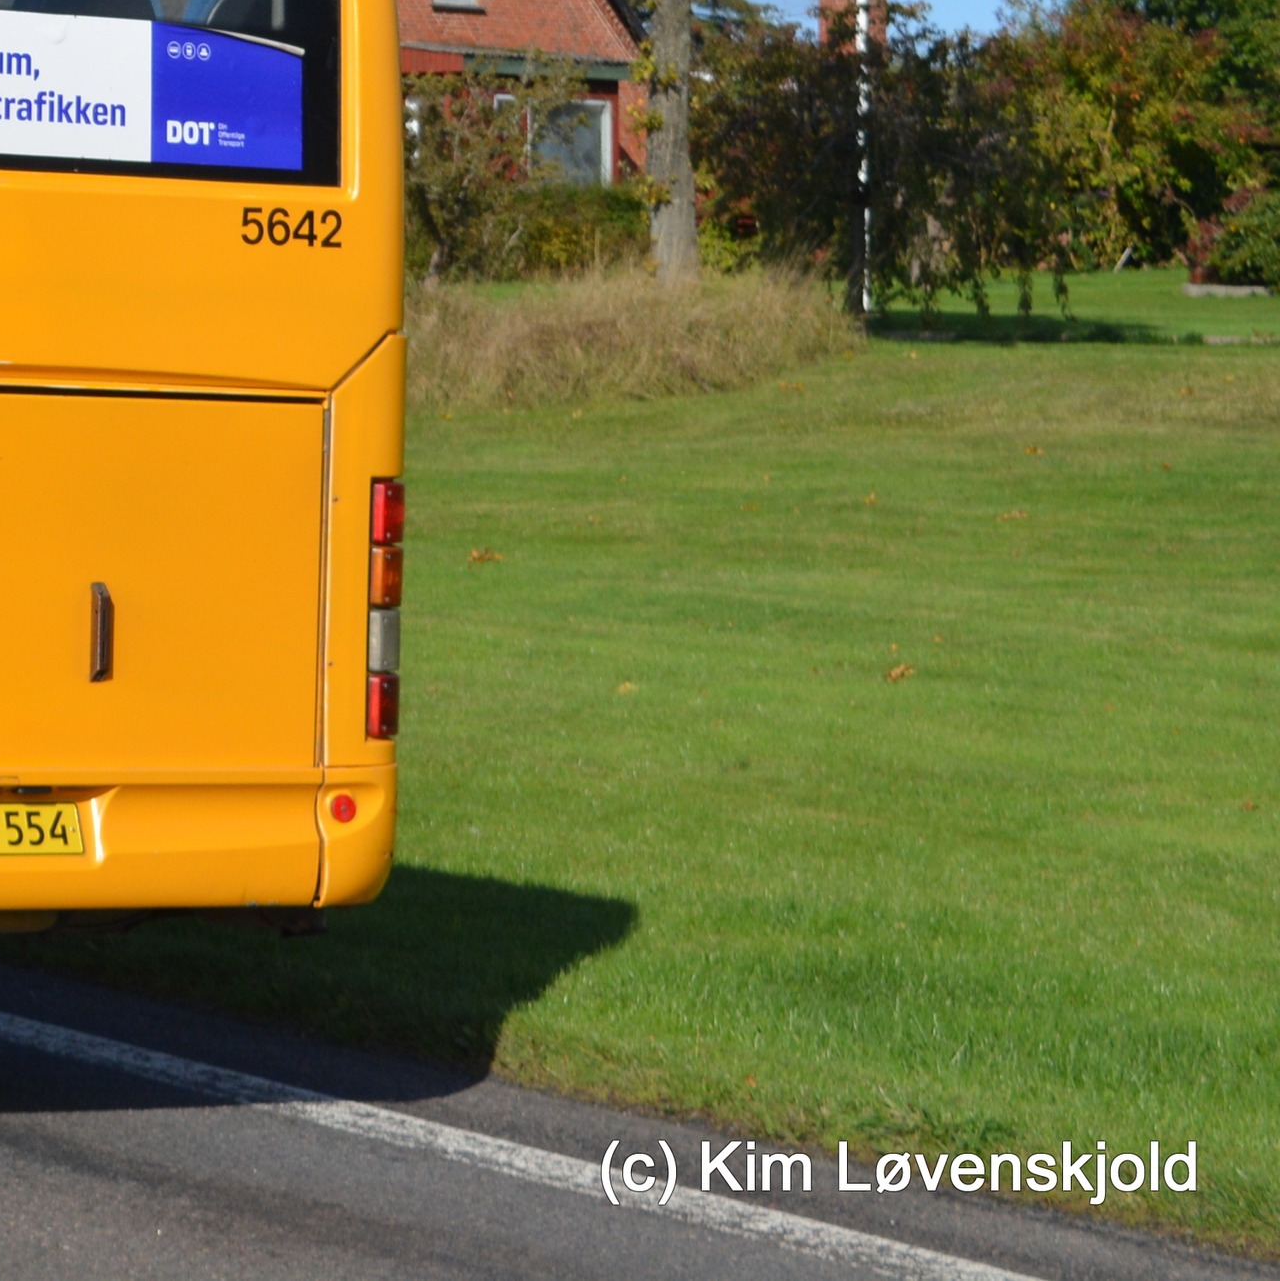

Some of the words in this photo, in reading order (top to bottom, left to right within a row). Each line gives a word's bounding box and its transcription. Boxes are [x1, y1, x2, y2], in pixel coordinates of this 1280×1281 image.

[166, 120, 215, 146] DOT
[241, 207, 342, 248] 5642
[4, 810, 68, 846] 554
